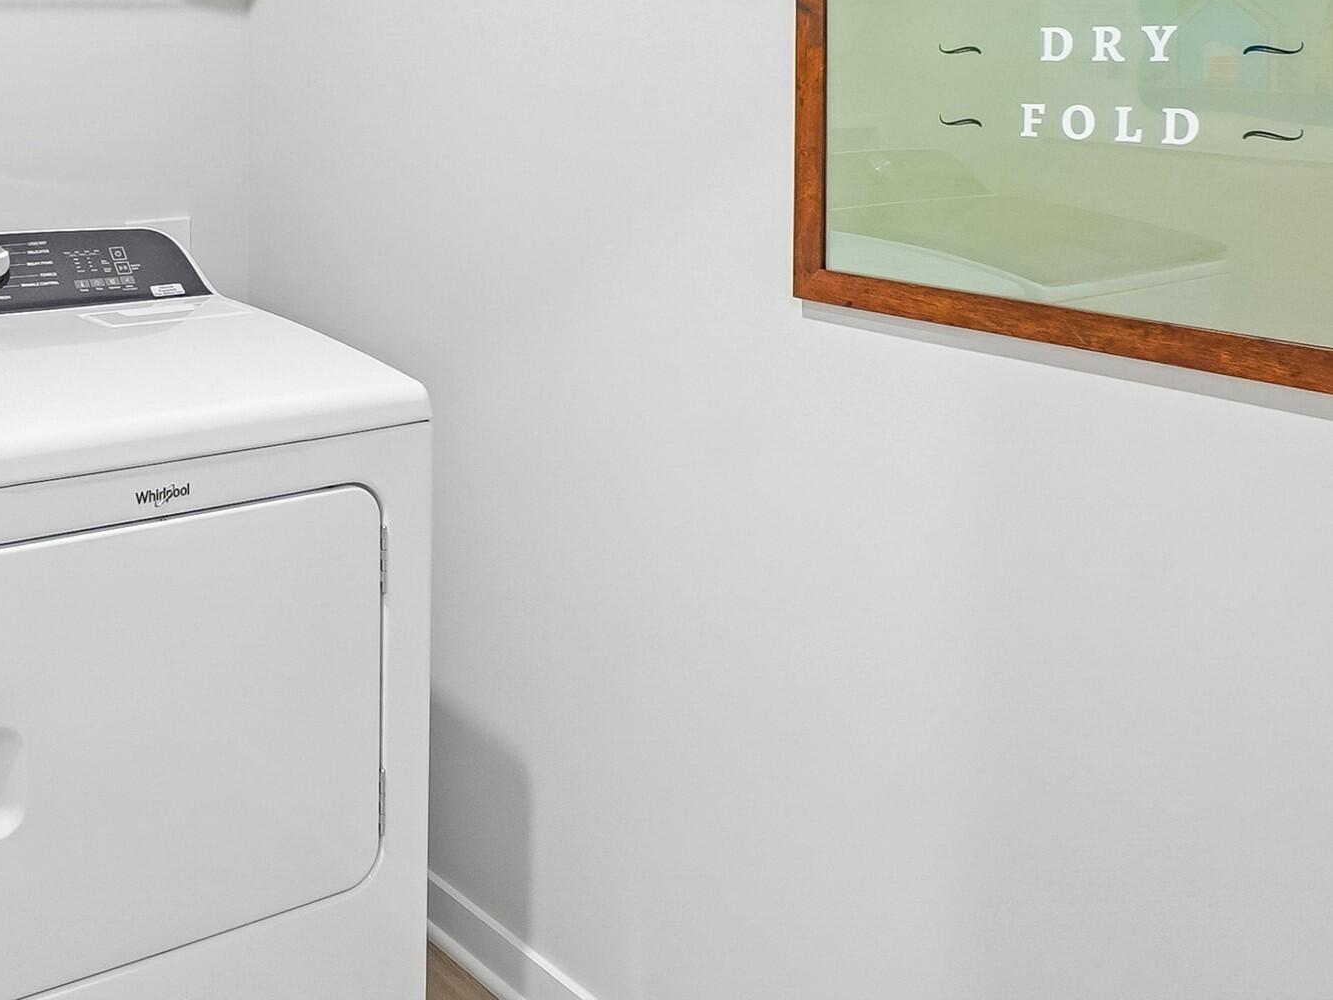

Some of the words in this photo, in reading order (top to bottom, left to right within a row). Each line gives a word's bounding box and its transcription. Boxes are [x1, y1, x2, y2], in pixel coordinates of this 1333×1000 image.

[1039, 25, 1179, 63] DRY
[1019, 103, 1201, 146] FOLD
[135, 482, 191, 508] Whirlpool
